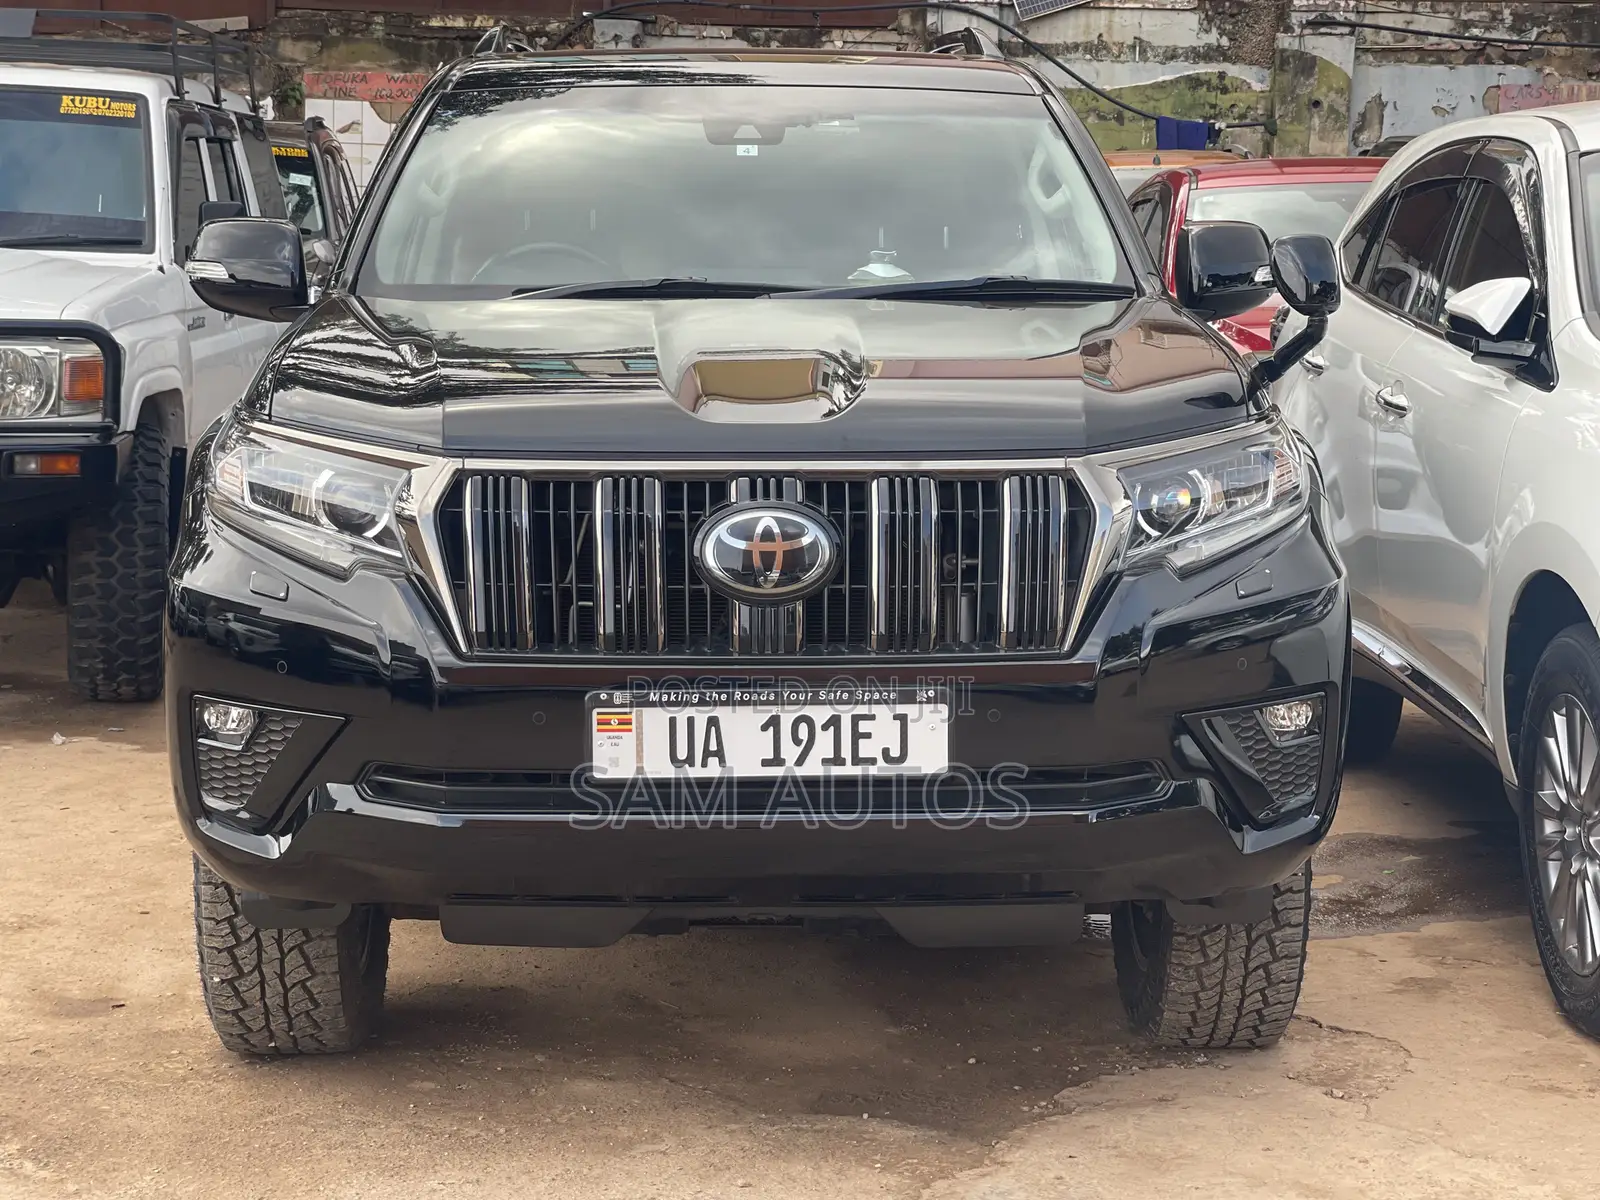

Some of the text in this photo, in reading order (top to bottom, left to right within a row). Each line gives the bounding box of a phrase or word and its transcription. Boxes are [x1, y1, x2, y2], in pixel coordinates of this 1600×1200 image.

[61, 95, 136, 112] KUBU MOTORS
[649, 690, 897, 703] Making the Roads Your Safe Space
[668, 713, 908, 768] UA 191EJ
